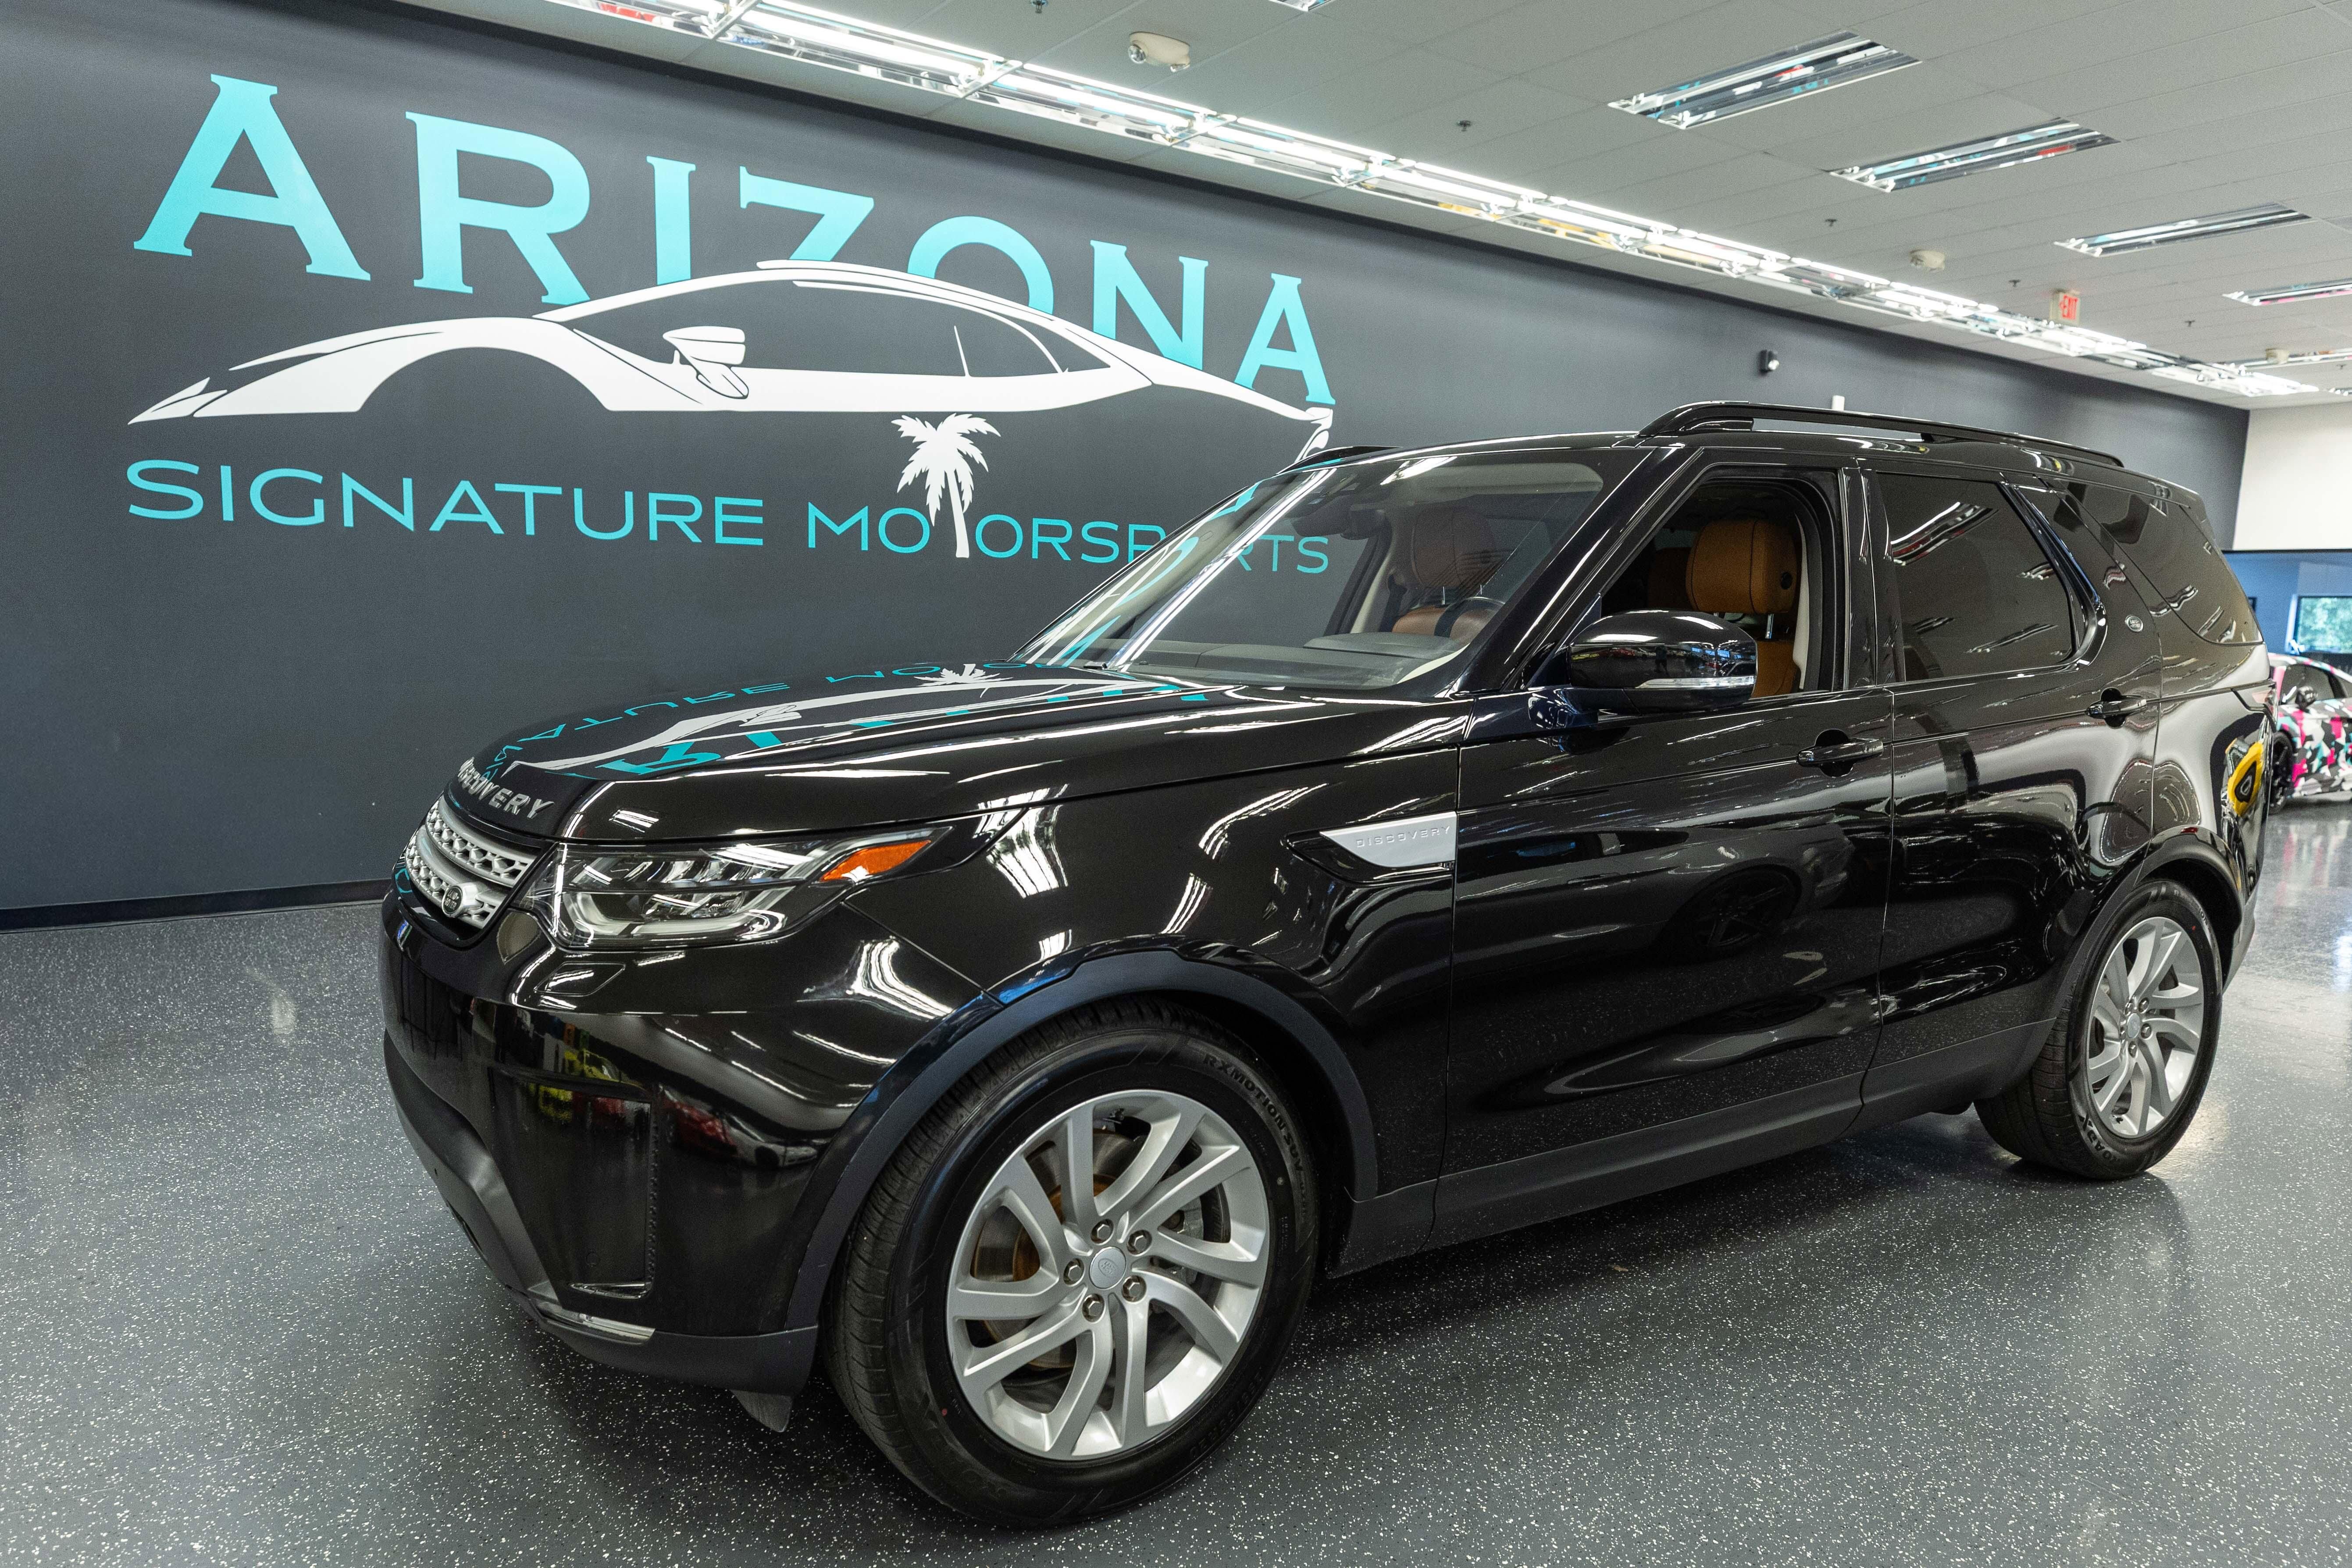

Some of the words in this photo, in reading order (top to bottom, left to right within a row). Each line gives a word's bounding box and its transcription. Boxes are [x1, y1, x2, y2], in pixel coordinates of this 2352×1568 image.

[133, 73, 1337, 407] ARIZONA
[2062, 294, 2078, 320] EXIT
[126, 459, 764, 547] SIGNATURE
[808, 501, 1329, 575] MOTORSPRTS
[1355, 826, 1450, 848] DISCOVERY
[1203, 1053, 1287, 1131] RXMOTION
[1284, 1132, 1304, 1172] SUV
